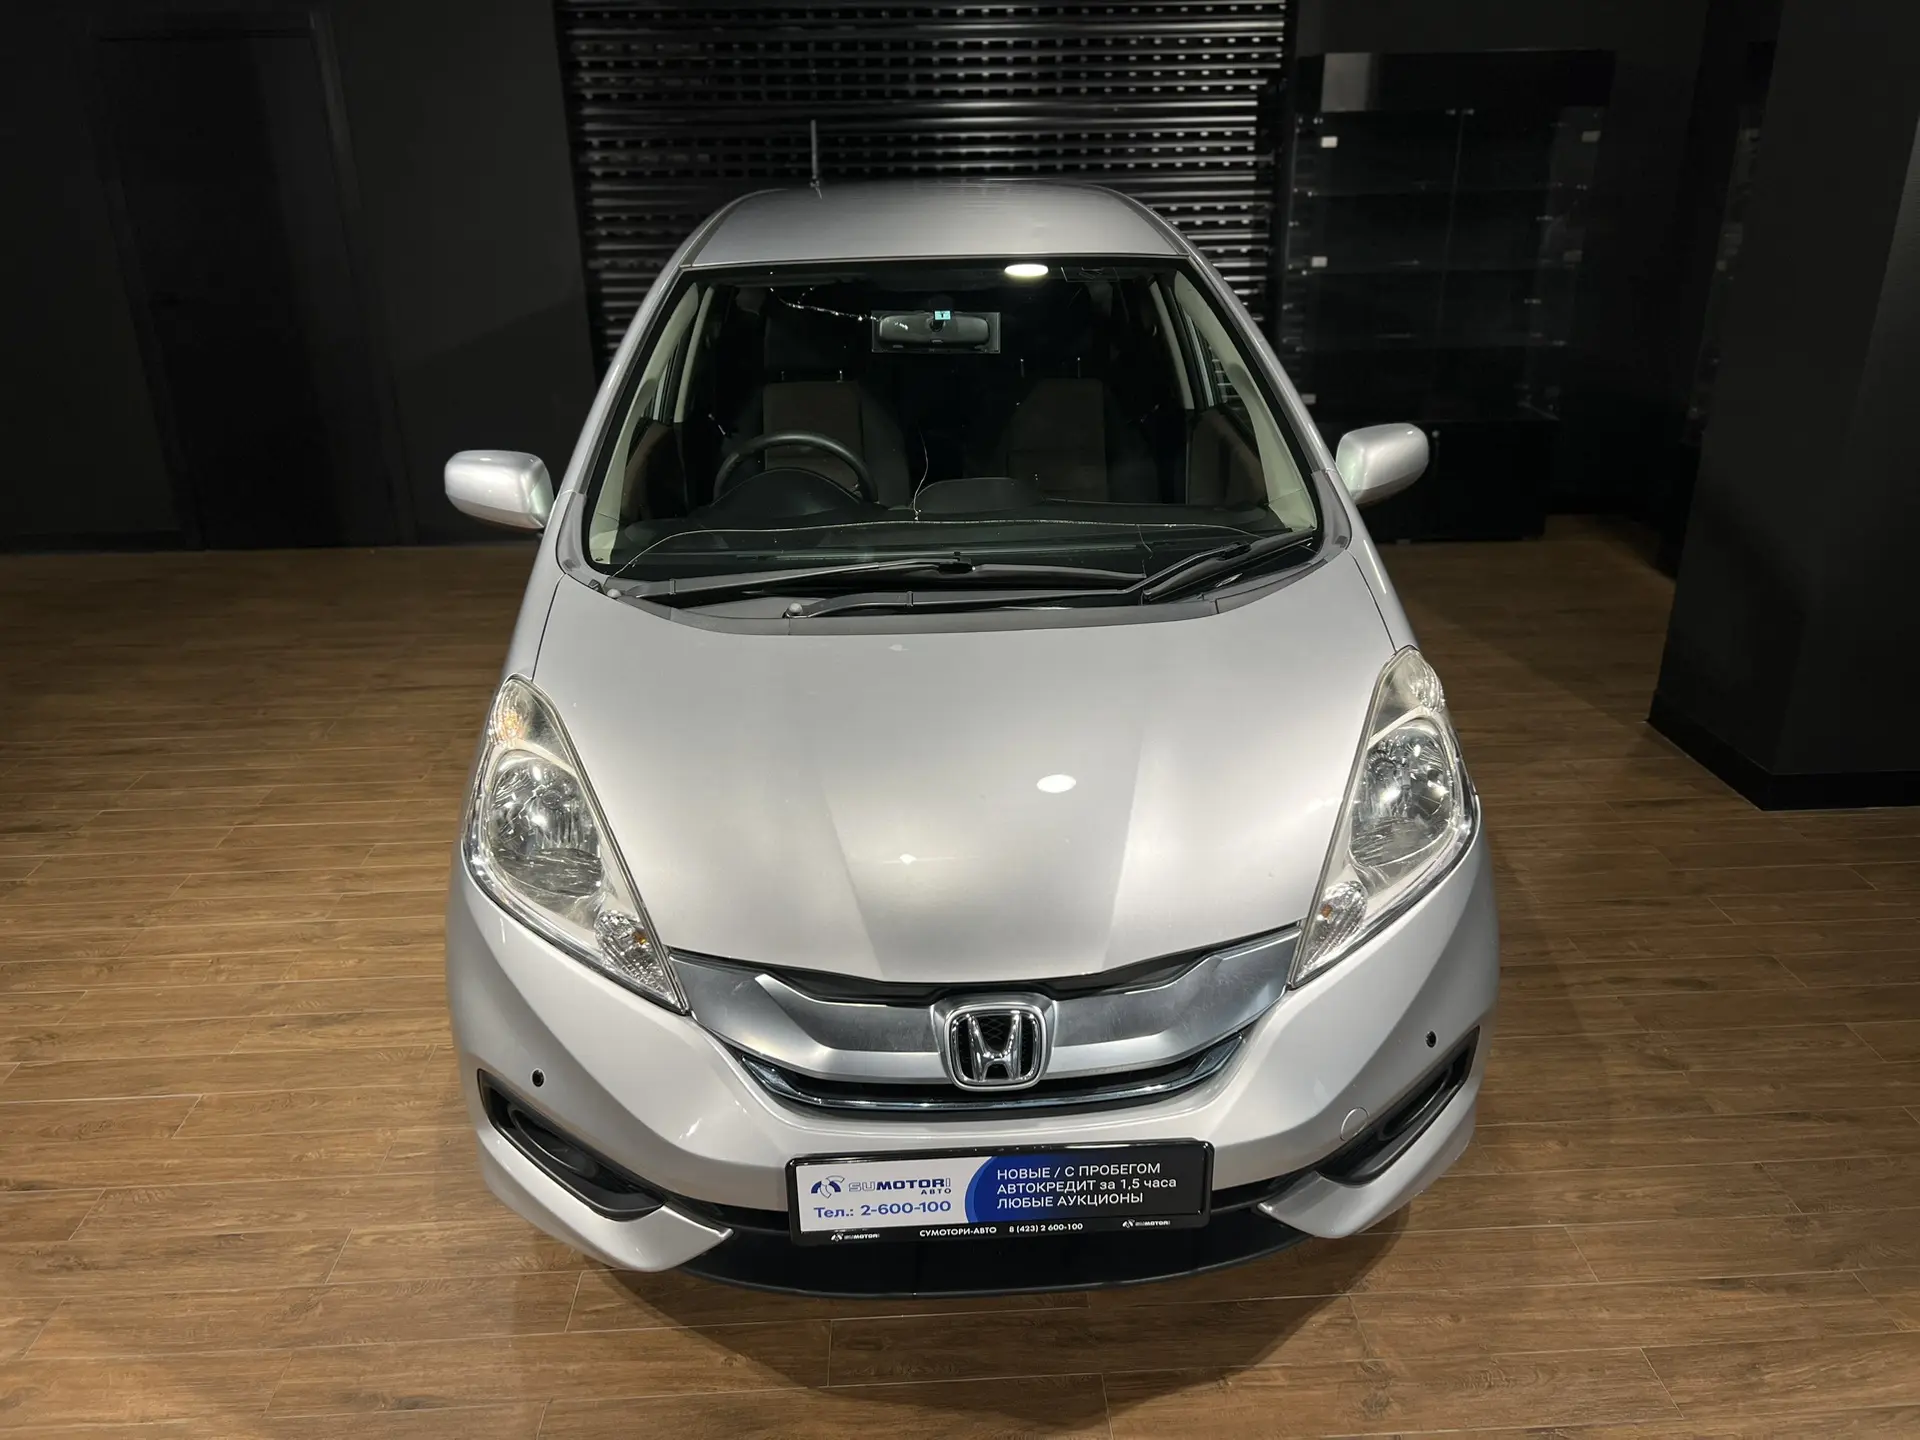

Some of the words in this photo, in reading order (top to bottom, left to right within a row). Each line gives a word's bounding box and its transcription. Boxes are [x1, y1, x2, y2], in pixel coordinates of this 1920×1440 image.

[997, 1167, 1050, 1180] НОВЫЕ
[1064, 1166, 1075, 1177] С
[1079, 1163, 1161, 1177] ПРОБЕГОМ
[849, 1178, 951, 1192] SUMOTORI
[996, 1179, 1096, 1195] АВТОКРЕДИТ
[1099, 1181, 1115, 1190] за
[1120, 1178, 1140, 1191] 1,5
[1143, 1178, 1177, 1188] часа
[813, 1207, 854, 1219] Тел.:
[860, 1200, 951, 1217] 2-600-100
[996, 1196, 1053, 1210] ЛЮБЫЕ
[1057, 1193, 1143, 1208] АУКЦИОНЫ
[919, 1226, 997, 1237] СУМОТОРИ-АВТО
[1016, 1225, 1039, 1234] (423)
[1040, 1225, 1047, 1233] 2
[1047, 1222, 1084, 1232] 600-100
